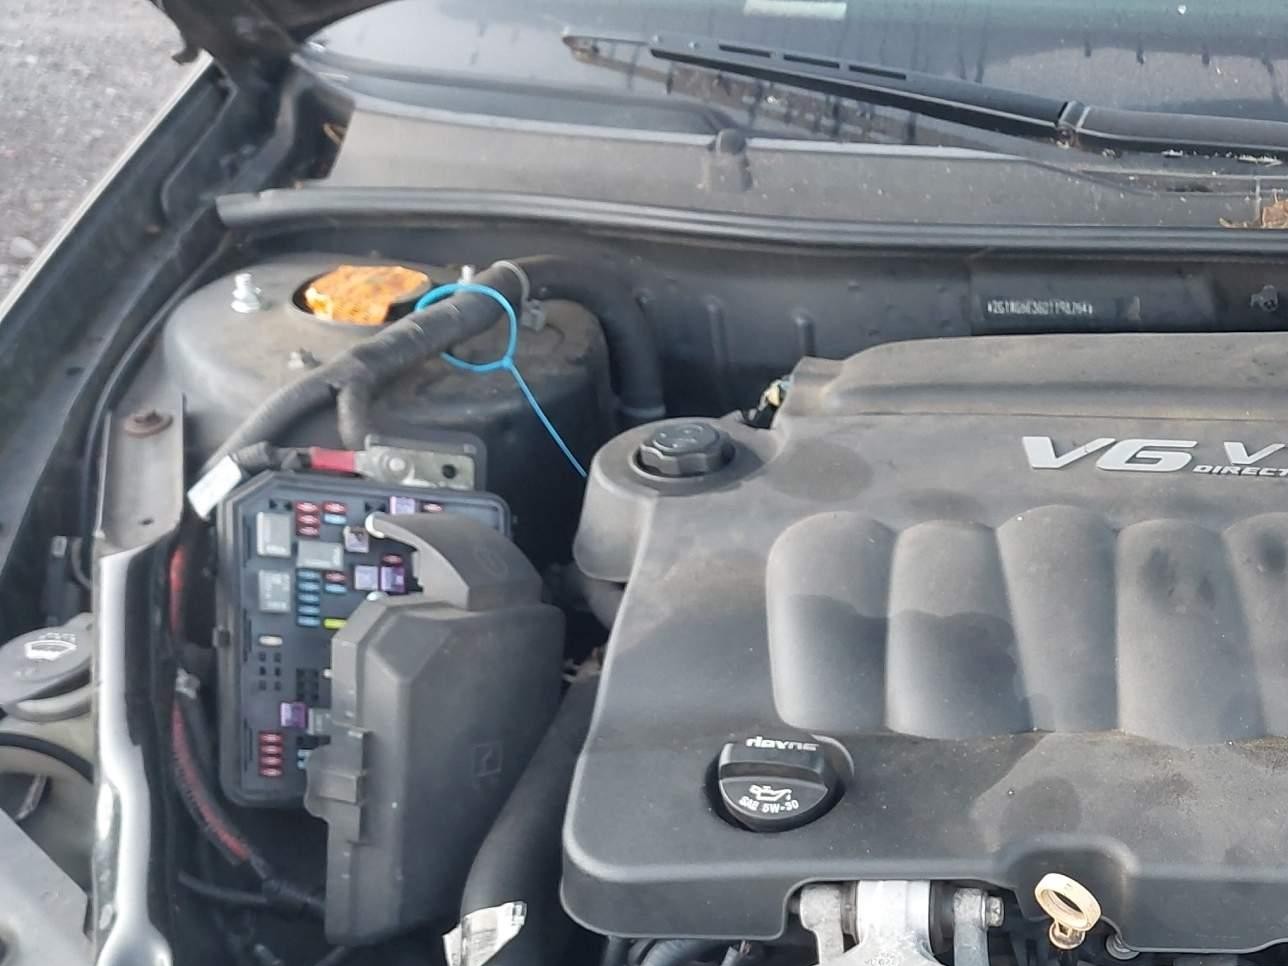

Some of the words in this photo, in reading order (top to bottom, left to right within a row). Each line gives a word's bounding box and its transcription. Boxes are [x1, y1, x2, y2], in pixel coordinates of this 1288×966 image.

[1022, 436, 1198, 472] V6
[739, 796, 759, 811] SAE
[762, 800, 799, 813] 5W-30
